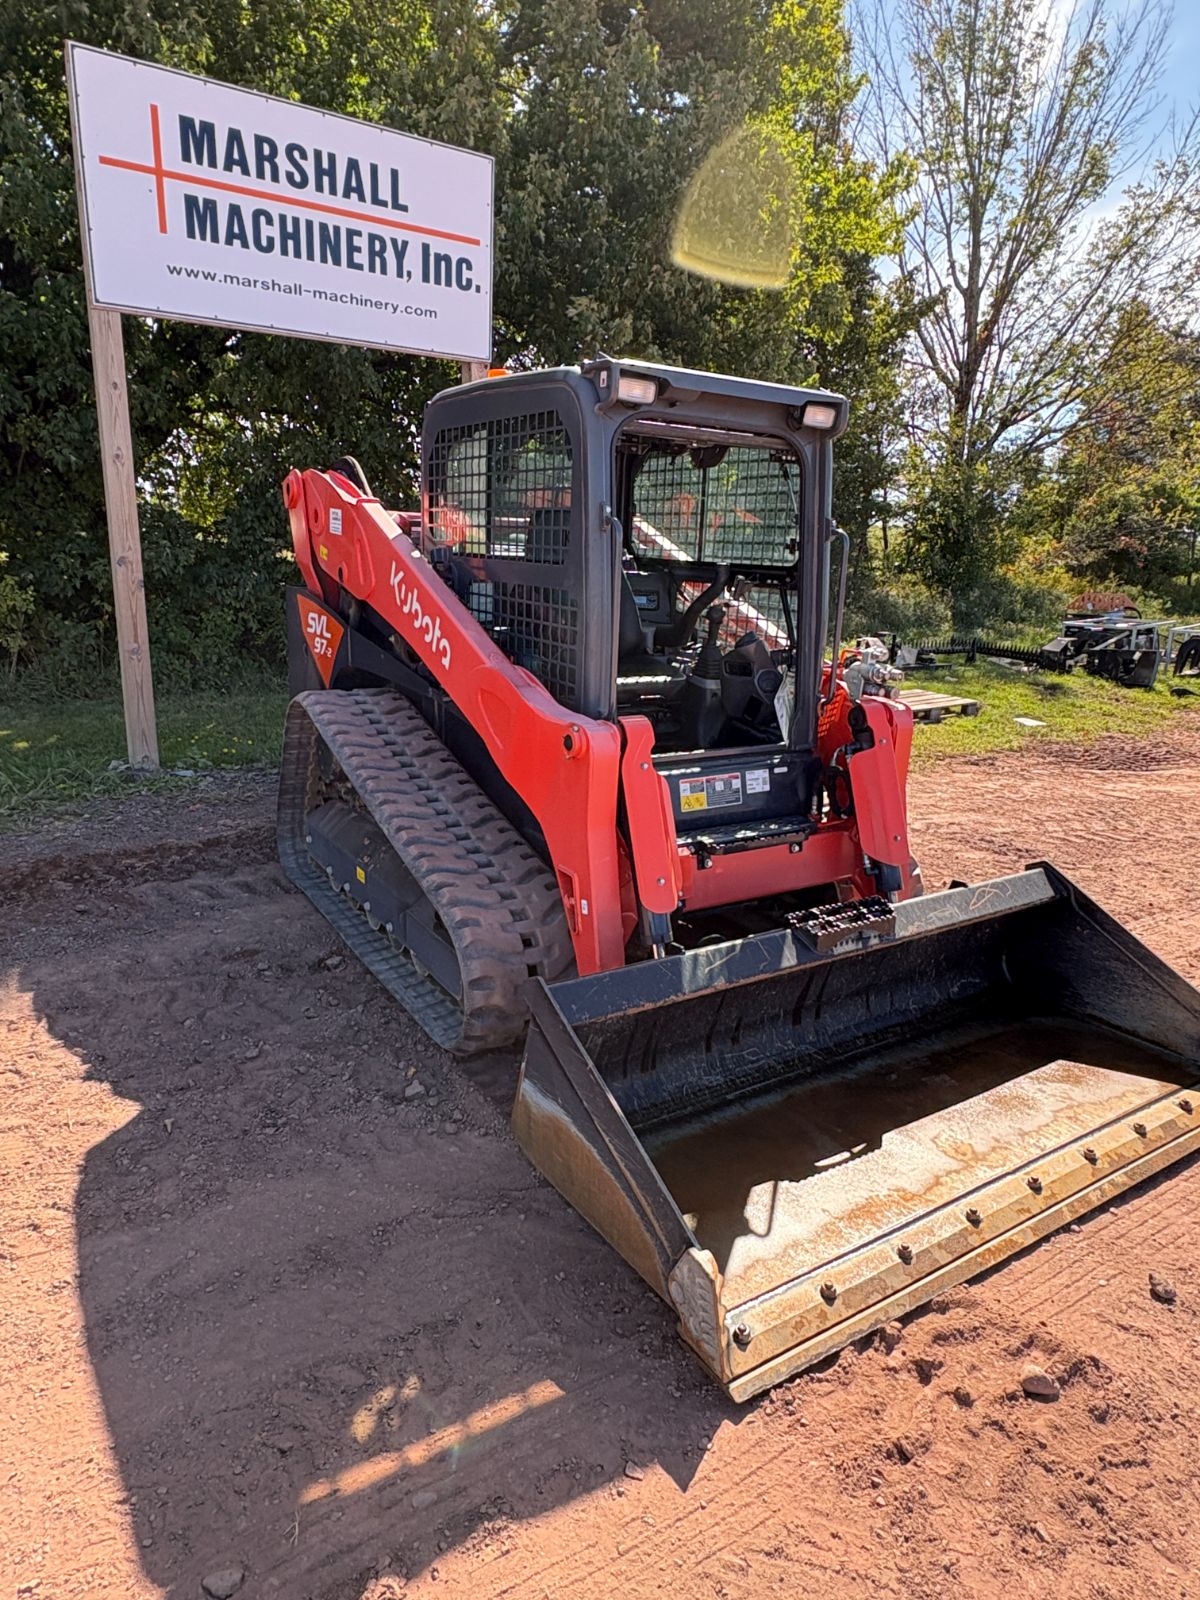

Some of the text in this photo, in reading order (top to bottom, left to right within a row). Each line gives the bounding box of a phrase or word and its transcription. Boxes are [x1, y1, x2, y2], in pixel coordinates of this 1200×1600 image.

[178, 114, 409, 213] MARSHALL
[167, 264, 438, 319] www.marshall-machinery.com
[184, 194, 481, 293] MACHINERY, Inc.
[307, 612, 331, 638] SVL
[390, 560, 451, 670] Kubota
